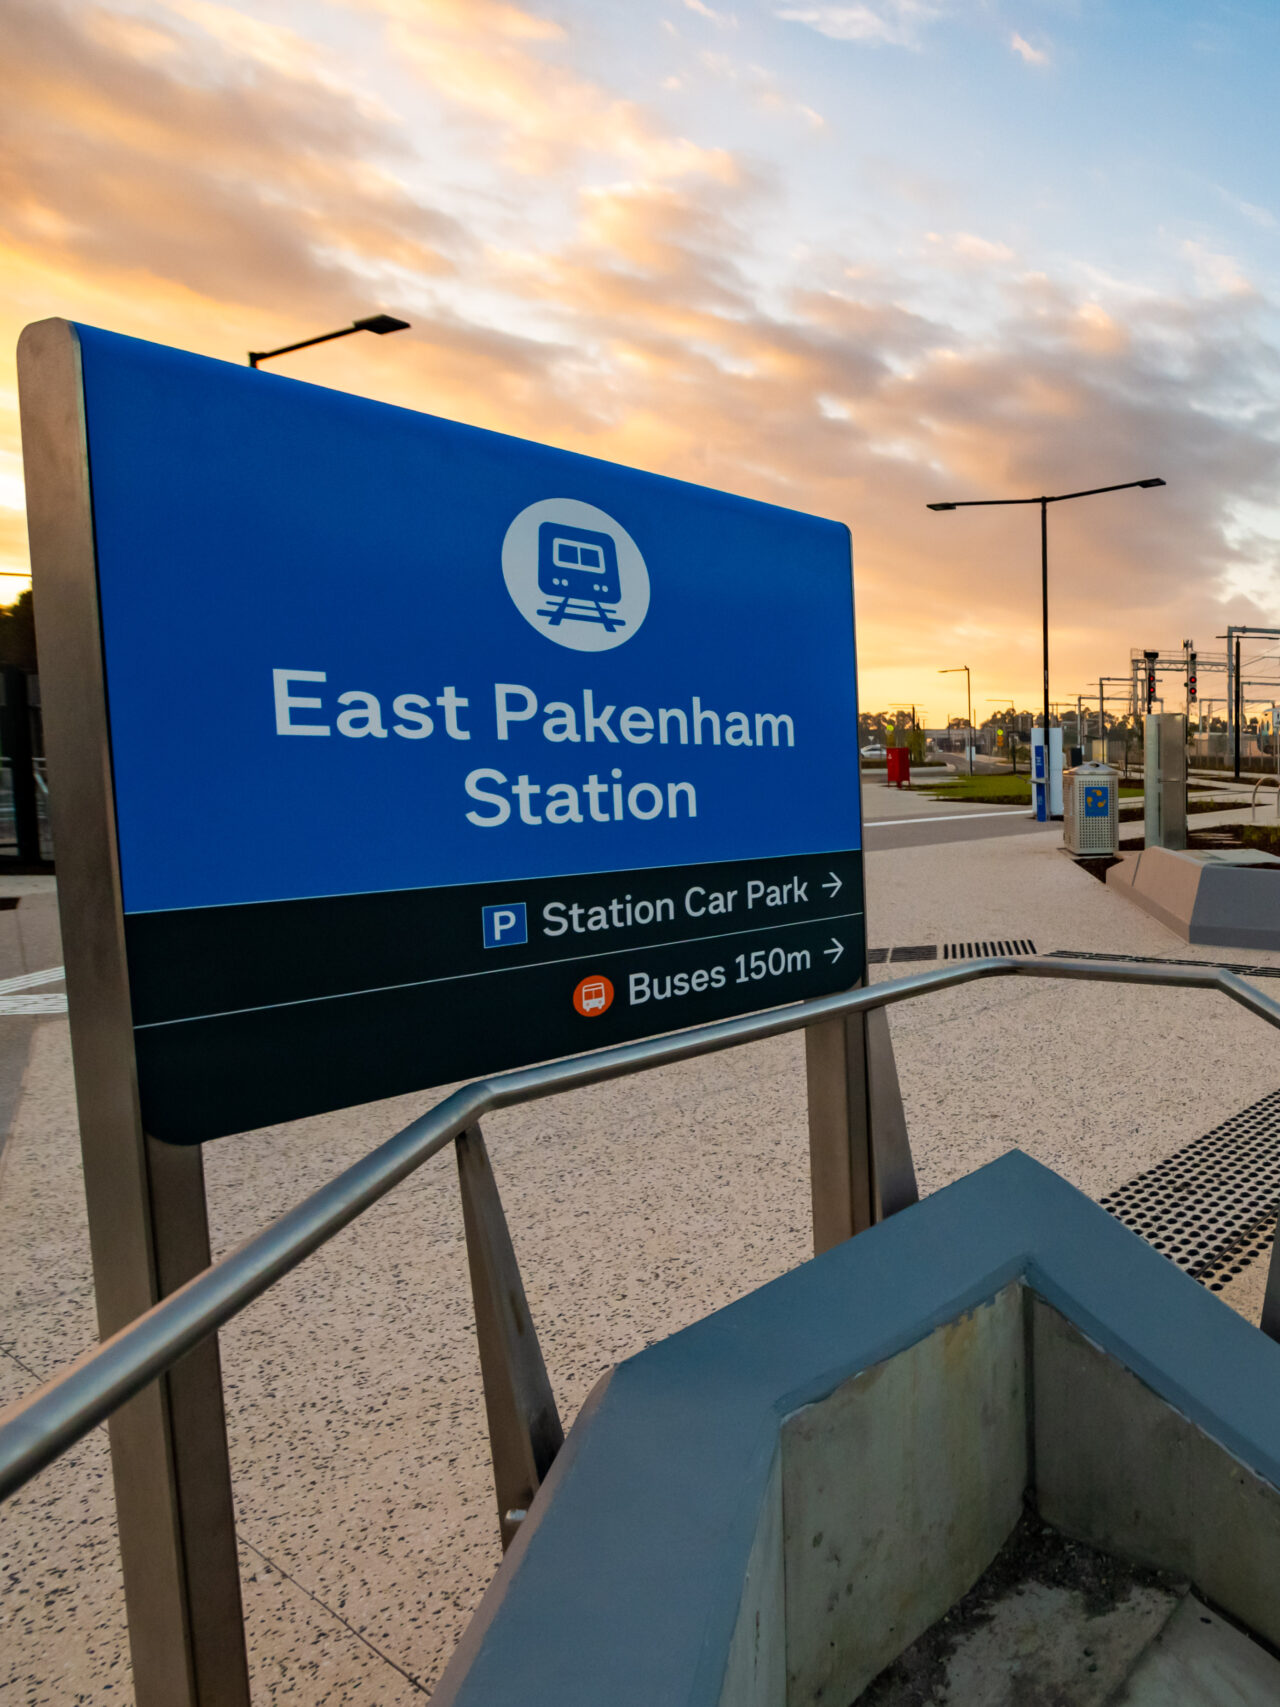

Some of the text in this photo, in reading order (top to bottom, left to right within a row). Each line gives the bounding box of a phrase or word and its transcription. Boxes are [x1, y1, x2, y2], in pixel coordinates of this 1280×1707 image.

[272, 668, 795, 747] East Pakenham
[464, 767, 697, 827] Station
[493, 875, 809, 941] P Station Car Park
[629, 949, 811, 1006] Buses 150m
